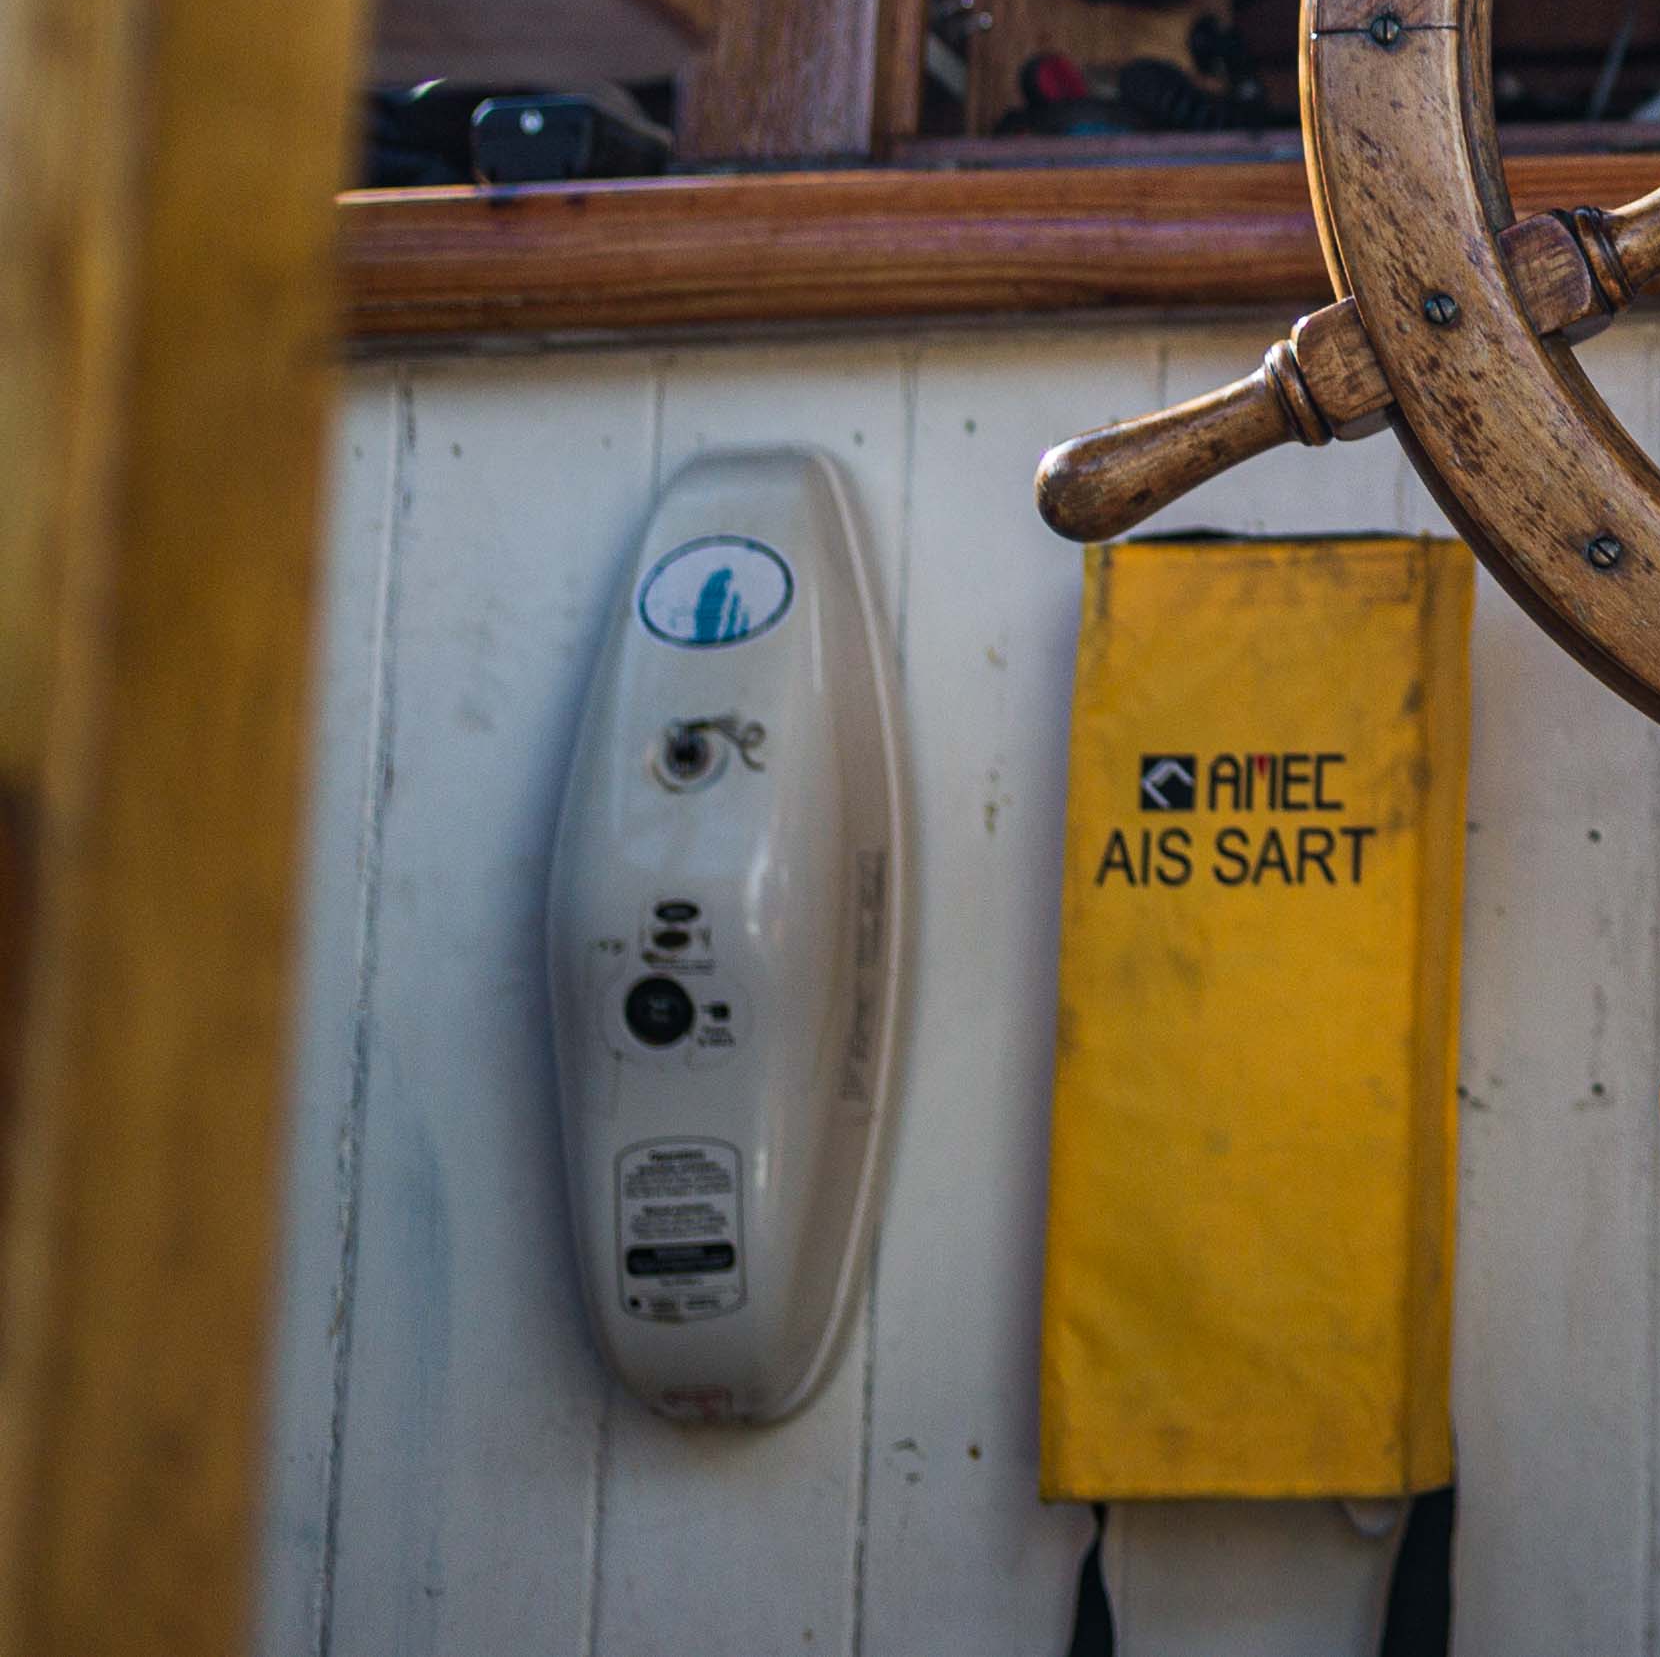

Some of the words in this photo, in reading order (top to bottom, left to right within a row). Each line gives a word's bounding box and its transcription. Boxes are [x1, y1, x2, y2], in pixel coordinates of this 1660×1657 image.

[1207, 753, 1347, 811] AMEC
[1095, 827, 1194, 887] AIS
[1212, 825, 1377, 887] SART
